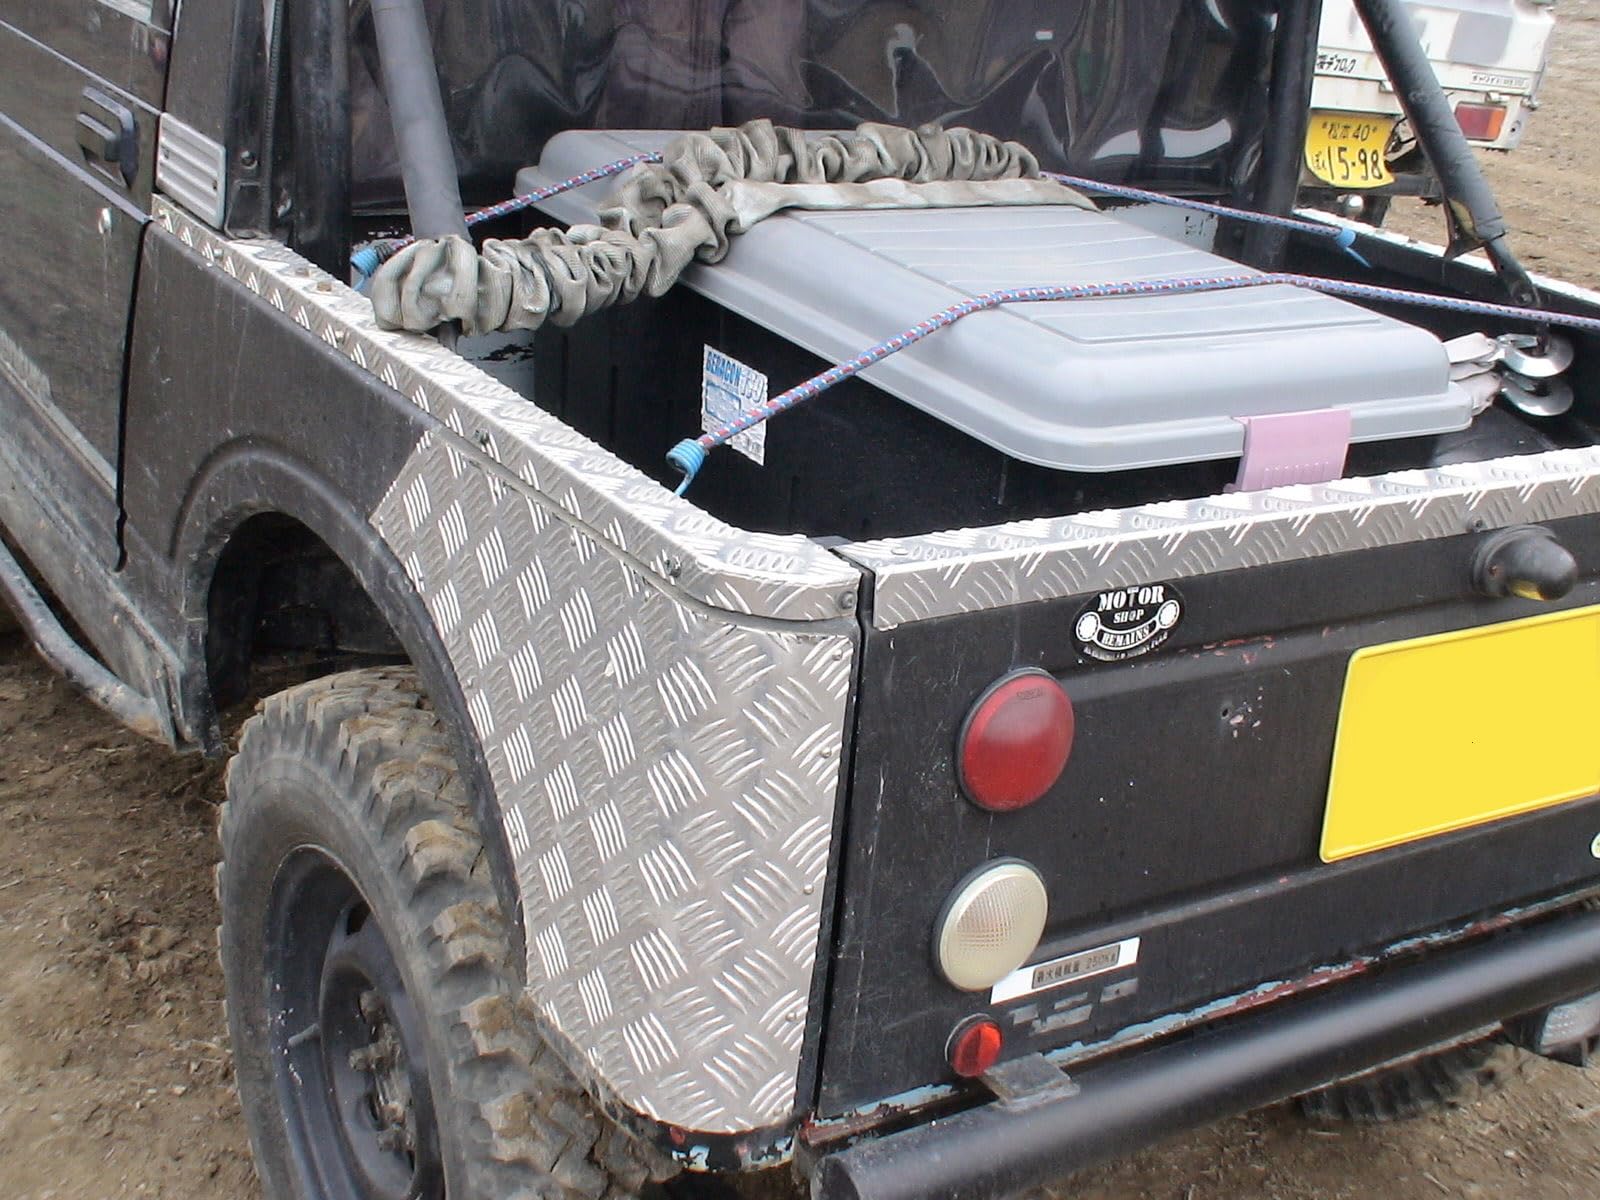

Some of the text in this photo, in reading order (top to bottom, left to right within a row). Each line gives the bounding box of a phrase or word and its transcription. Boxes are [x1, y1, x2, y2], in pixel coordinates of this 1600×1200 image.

[1353, 124, 1370, 141] 40
[1098, 585, 1164, 612] MOTOR
[1113, 609, 1144, 624] SHOP
[1101, 625, 1150, 647] REMAINS
